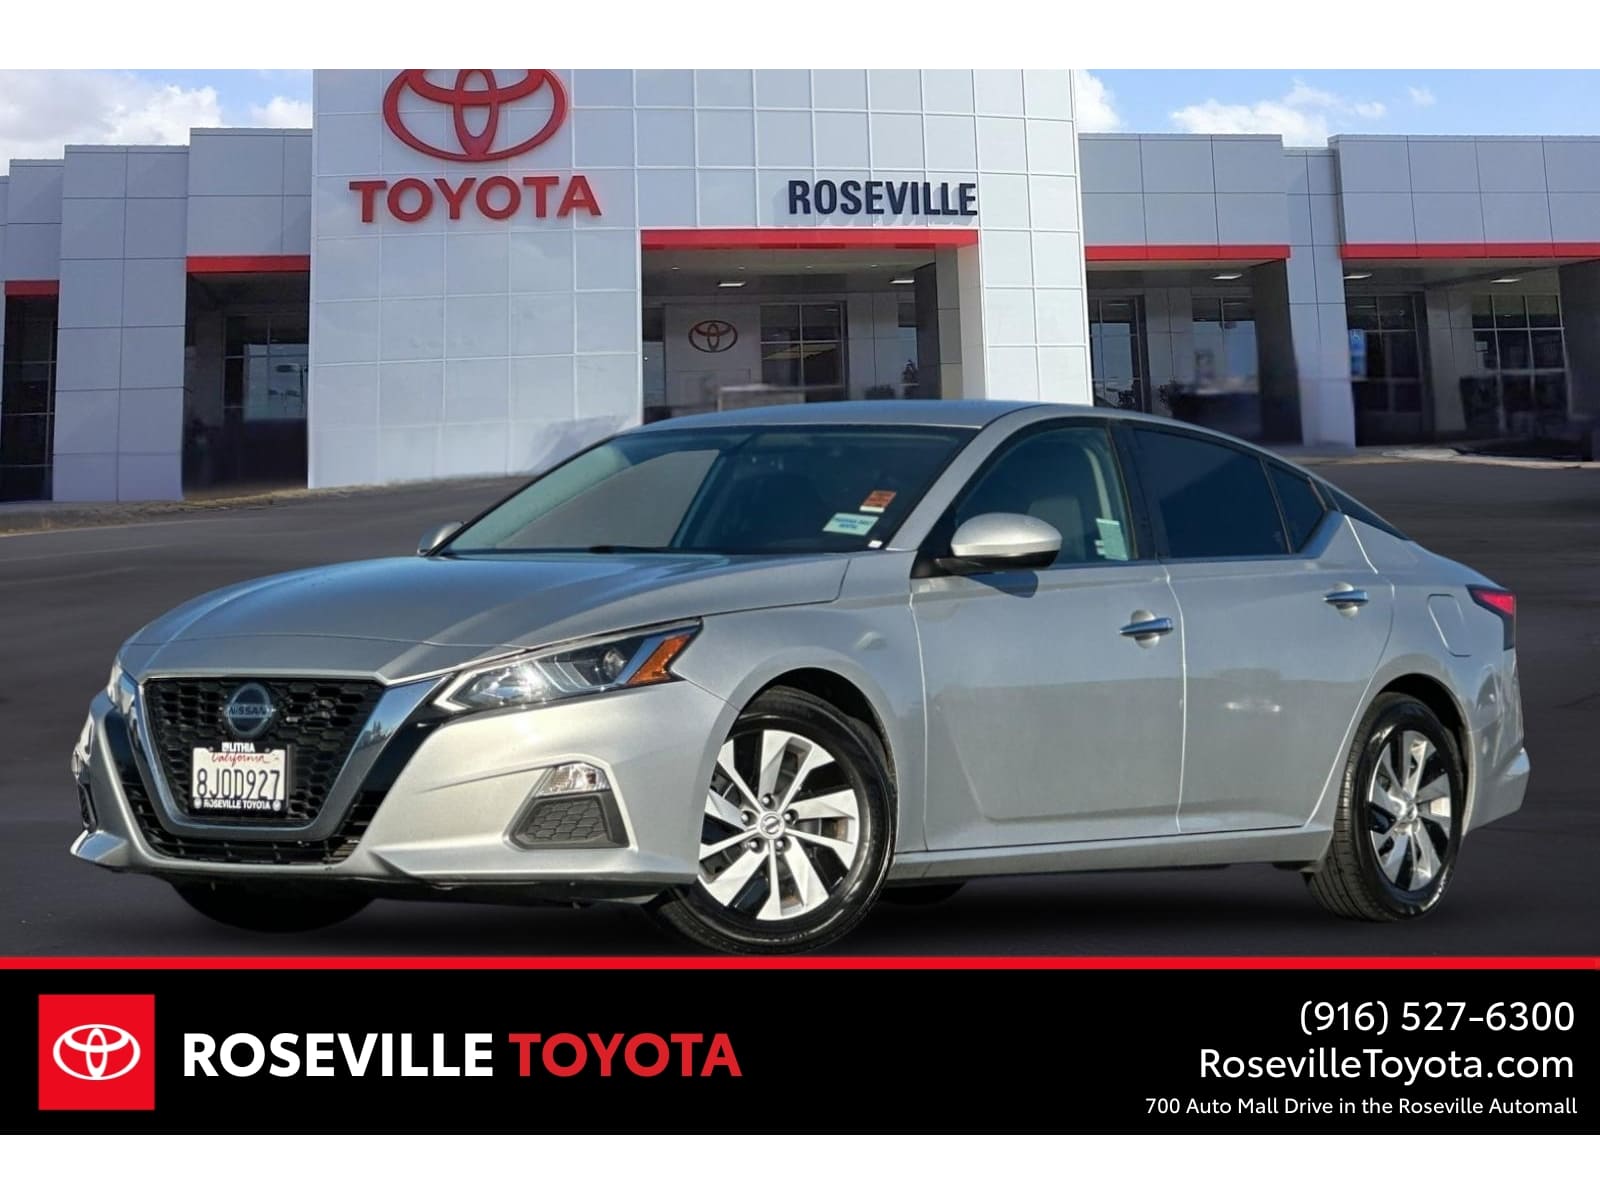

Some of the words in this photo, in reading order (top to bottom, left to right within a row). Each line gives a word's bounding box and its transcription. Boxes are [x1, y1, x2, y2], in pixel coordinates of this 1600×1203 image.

[349, 175, 602, 223] TOYOTA
[788, 180, 978, 216] ROSEVILLE
[229, 704, 266, 716] NISSAN
[229, 742, 255, 752] LITHIA
[203, 799, 241, 809] ROSEVILLE
[243, 800, 271, 810] TOYOTA
